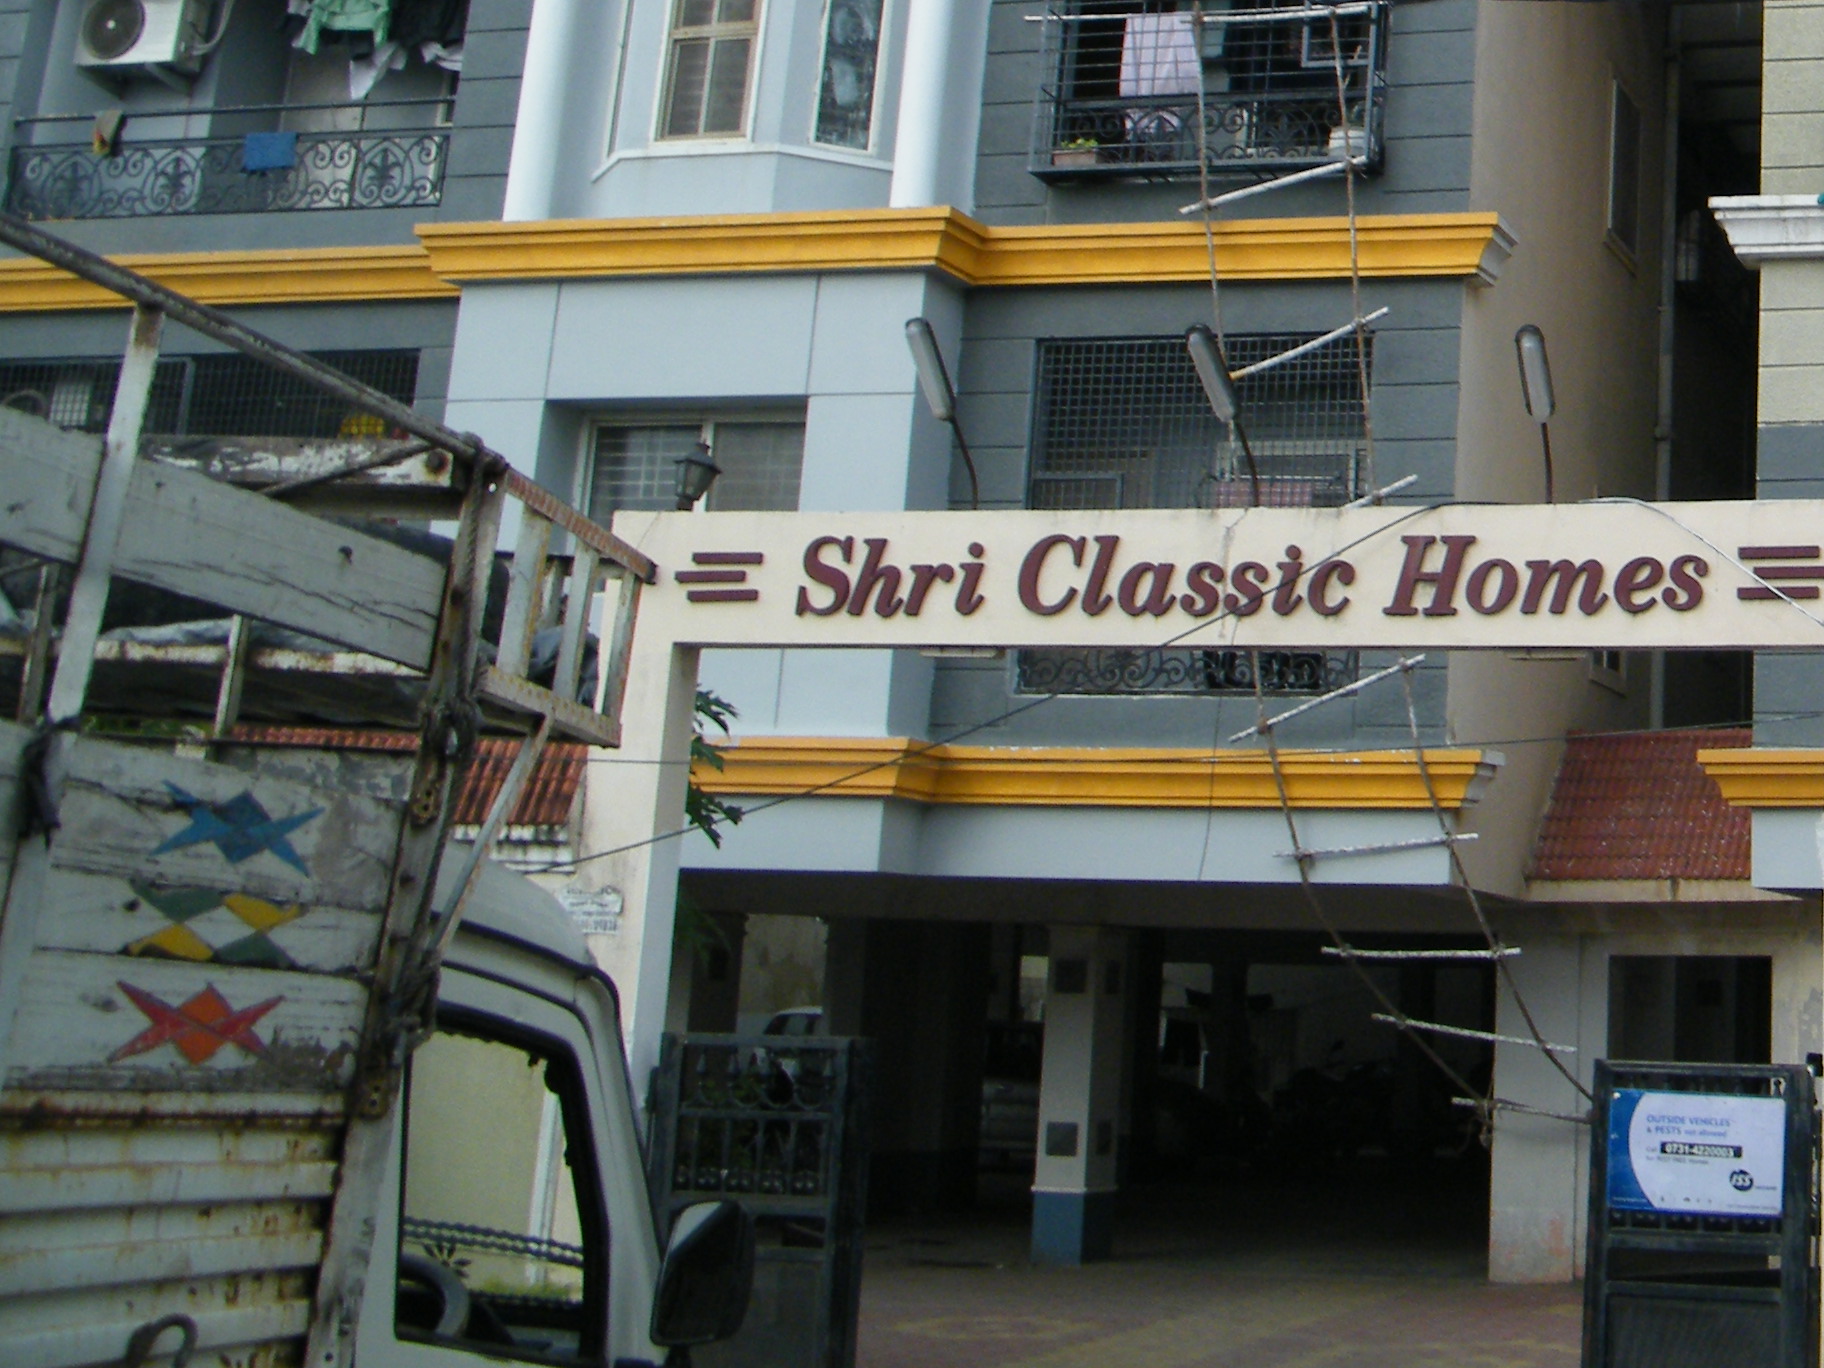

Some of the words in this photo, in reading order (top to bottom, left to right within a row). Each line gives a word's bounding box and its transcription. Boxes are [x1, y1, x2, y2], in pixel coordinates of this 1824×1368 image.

[795, 535, 986, 617] Shri
[1018, 533, 1356, 616] Classic
[1385, 534, 1710, 616] Homes
[1647, 1114, 1686, 1124] OUTSIDE
[1689, 1117, 1731, 1127] VEHICLES
[1655, 1126, 1682, 1135] PESTS
